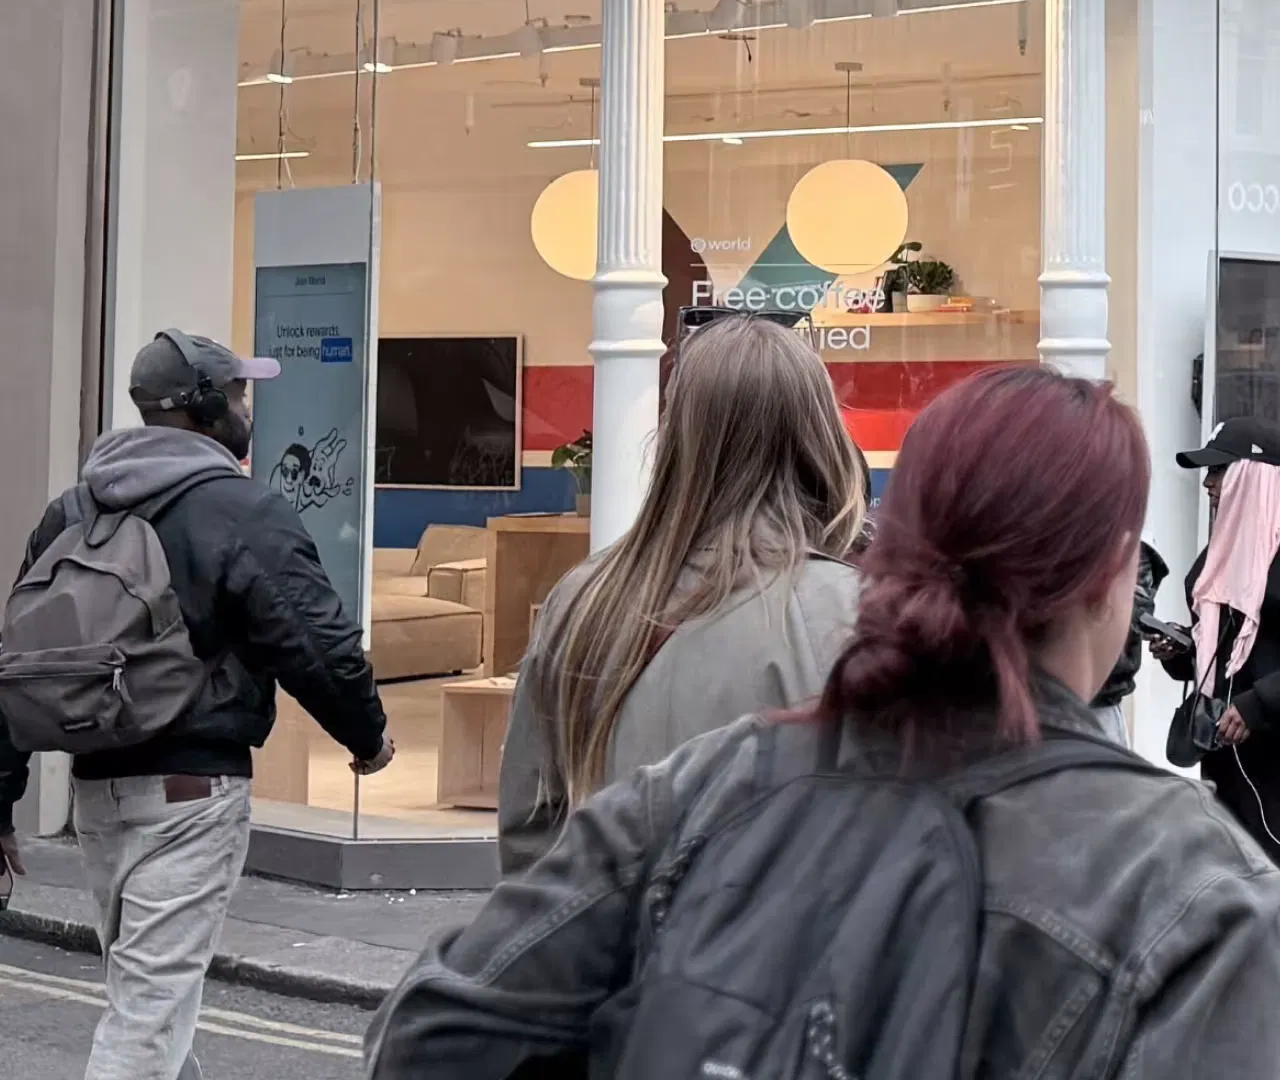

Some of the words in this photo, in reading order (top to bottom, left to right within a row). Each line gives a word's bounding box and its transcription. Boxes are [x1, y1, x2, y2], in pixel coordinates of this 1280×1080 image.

[708, 237, 751, 251] world
[692, 280, 765, 310] Free
[277, 324, 304, 338] Unlock
[297, 345, 320, 360] being
